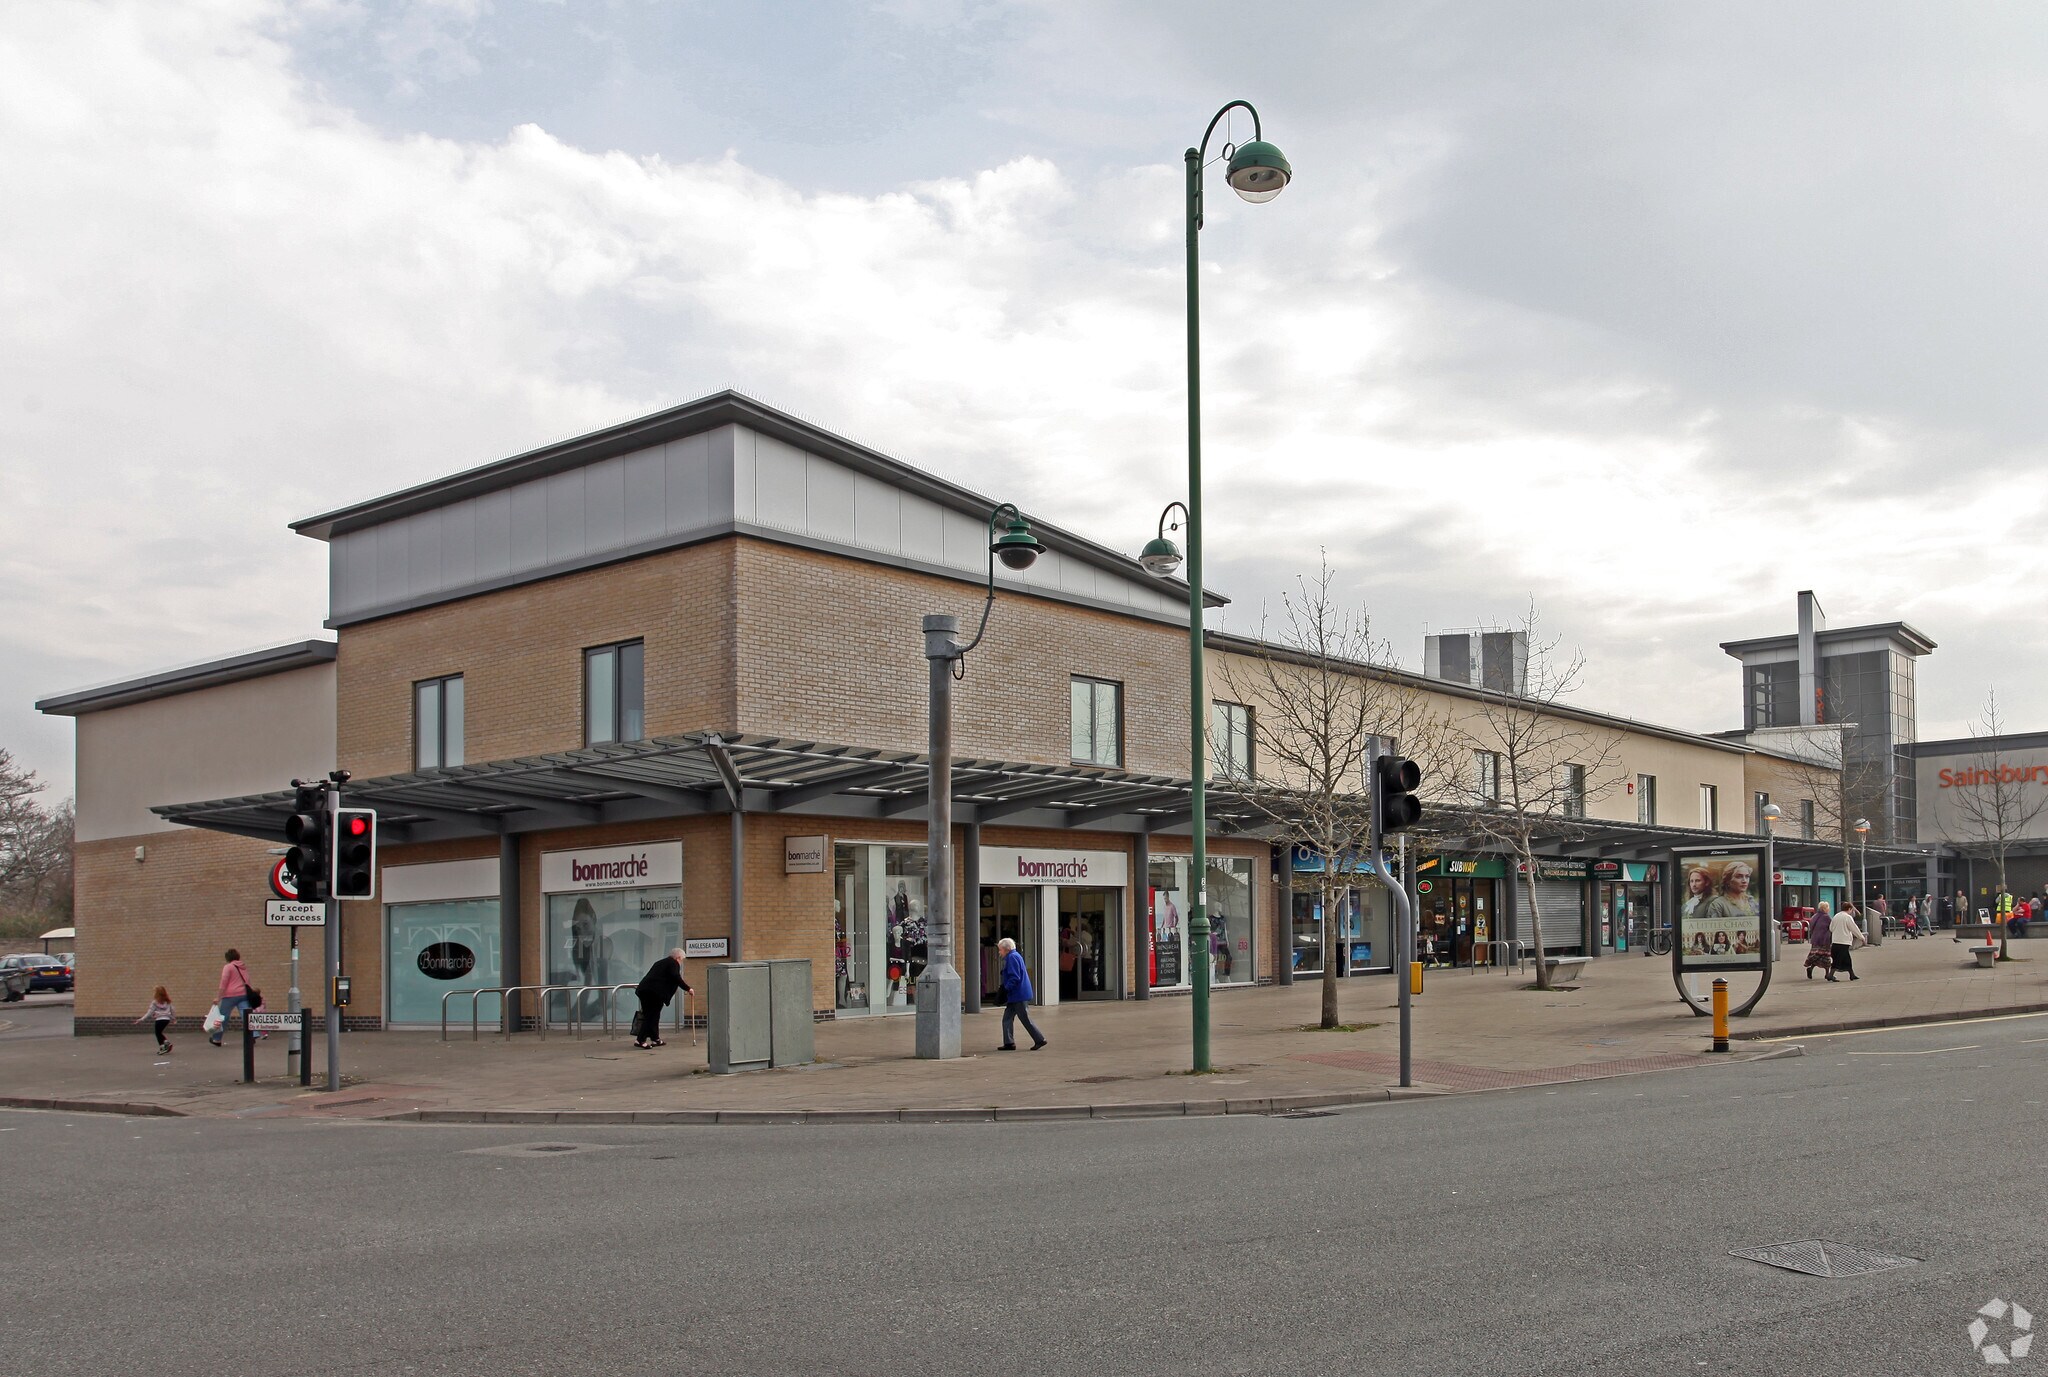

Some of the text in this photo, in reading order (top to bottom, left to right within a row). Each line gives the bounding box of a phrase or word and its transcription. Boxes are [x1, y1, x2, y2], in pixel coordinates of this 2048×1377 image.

[788, 849, 821, 861] bonmarché
[572, 853, 648, 881] bonmarché
[1018, 855, 1088, 878] bonmarché
[1449, 860, 1478, 873] SUBWAY
[279, 904, 314, 913] Except
[270, 913, 285, 921] for
[689, 942, 711, 950] ANGLESEA
[420, 951, 473, 970] Bonmarché
[249, 1015, 302, 1024] ANGLESEA ROAD
